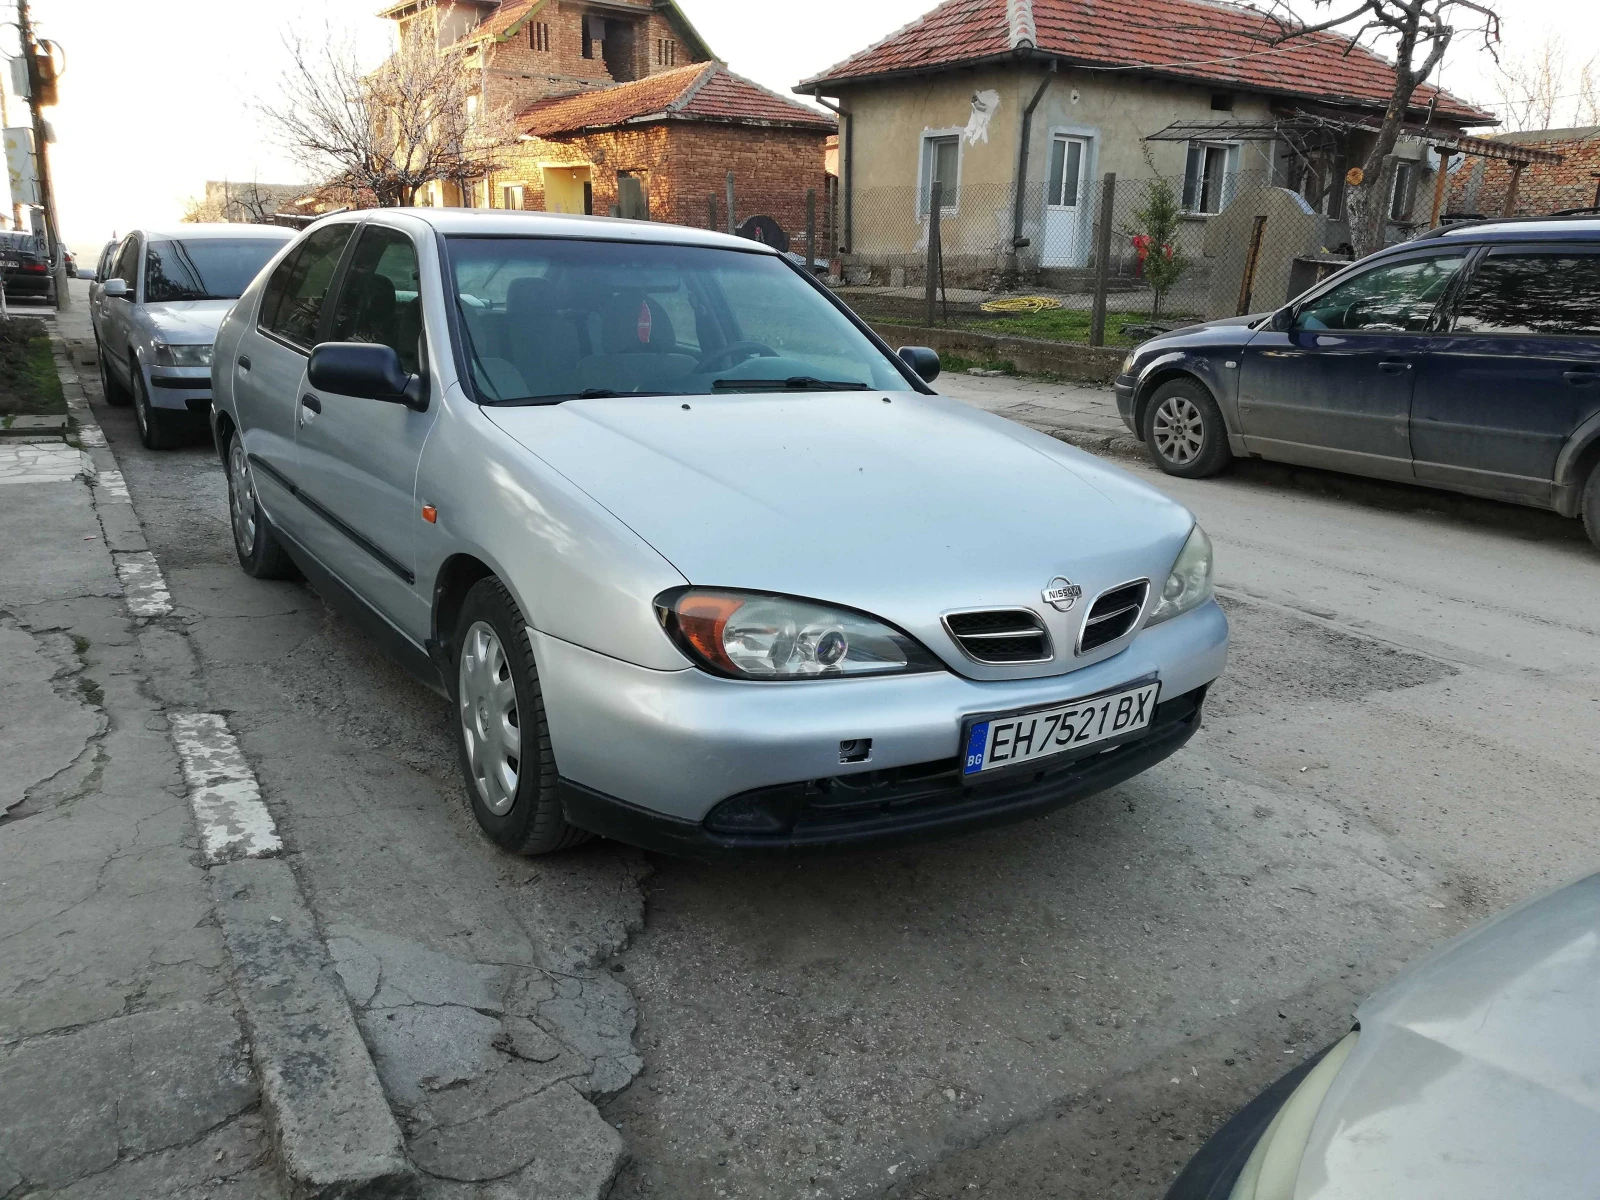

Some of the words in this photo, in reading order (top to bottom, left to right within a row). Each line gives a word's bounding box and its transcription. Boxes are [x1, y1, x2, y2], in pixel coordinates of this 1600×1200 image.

[35, 238, 46, 251] 18
[1048, 584, 1079, 599] NISSAN
[967, 754, 983, 767] BG
